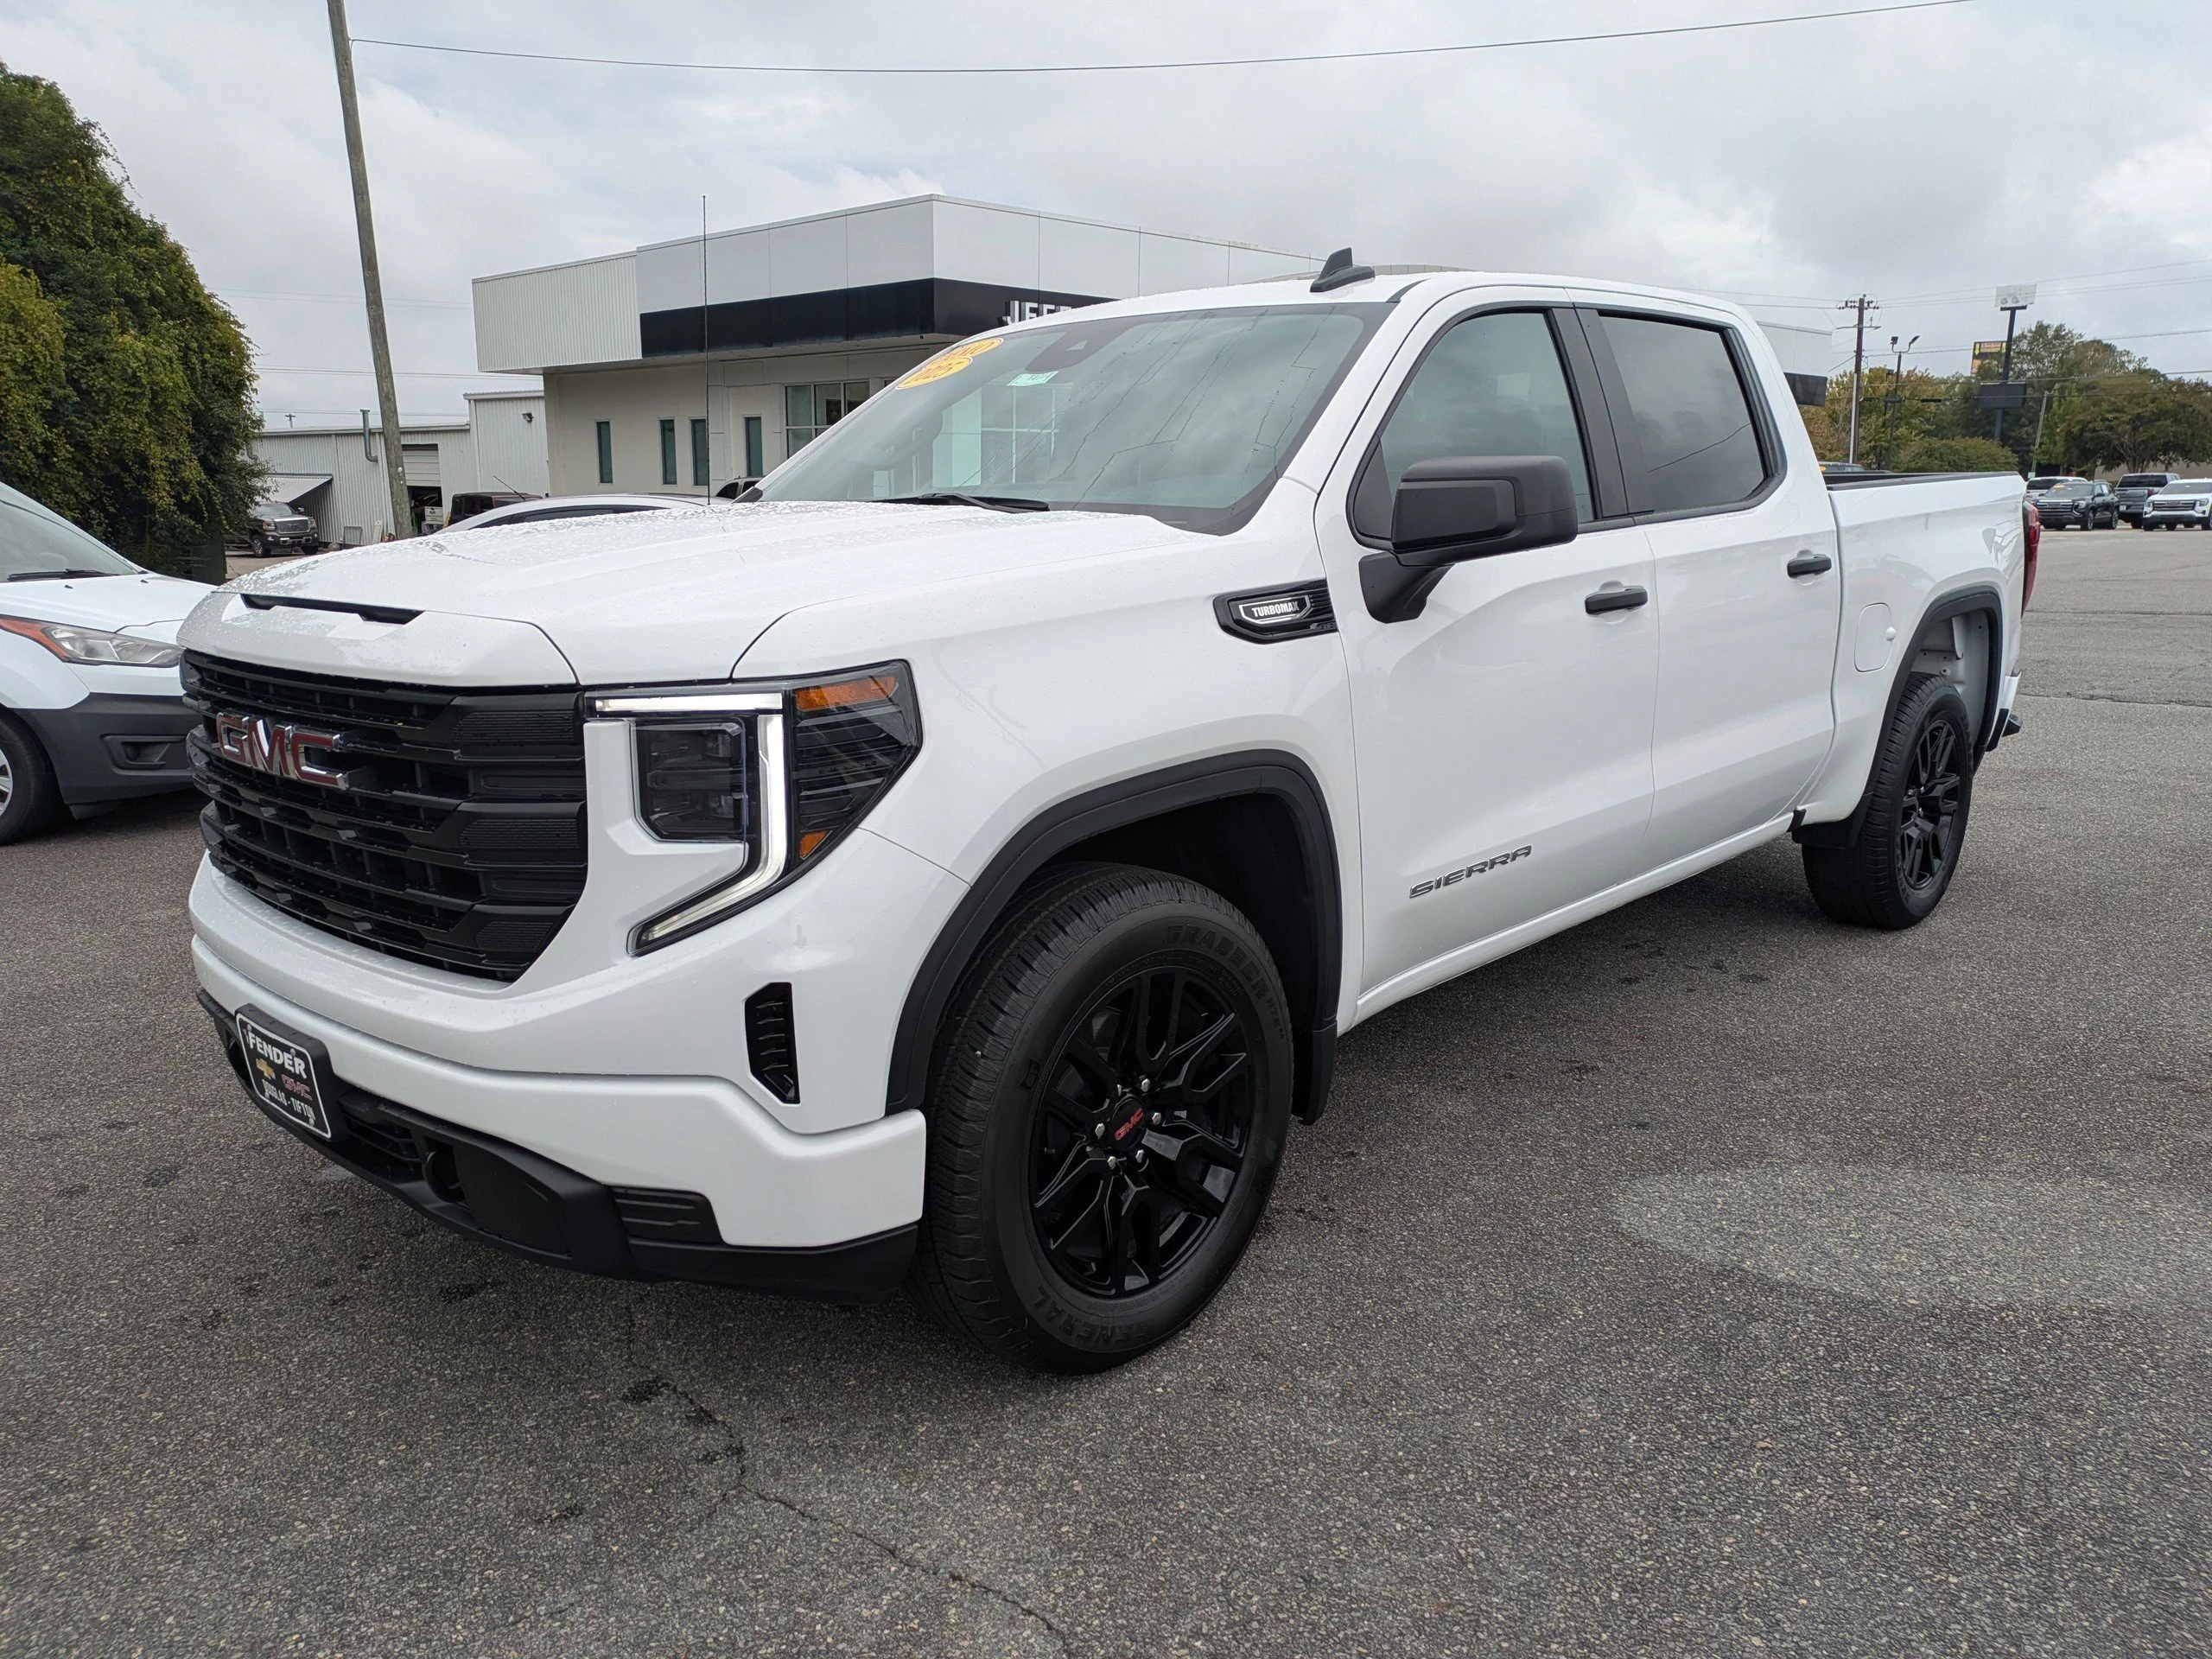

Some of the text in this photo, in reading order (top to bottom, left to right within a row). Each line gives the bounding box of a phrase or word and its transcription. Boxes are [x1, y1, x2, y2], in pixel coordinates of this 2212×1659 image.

[1002, 299, 1072, 325] JEF
[1251, 601, 1300, 618] TURBOMAX
[217, 712, 348, 791] GMC
[1409, 845, 1532, 899] SIERRA
[1161, 925, 1269, 999] GRABBER
[247, 1031, 308, 1079] FENDER
[282, 1074, 312, 1101] GMC
[1115, 1108, 1143, 1141] GMC
[1033, 1284, 1148, 1346] GENERAL
